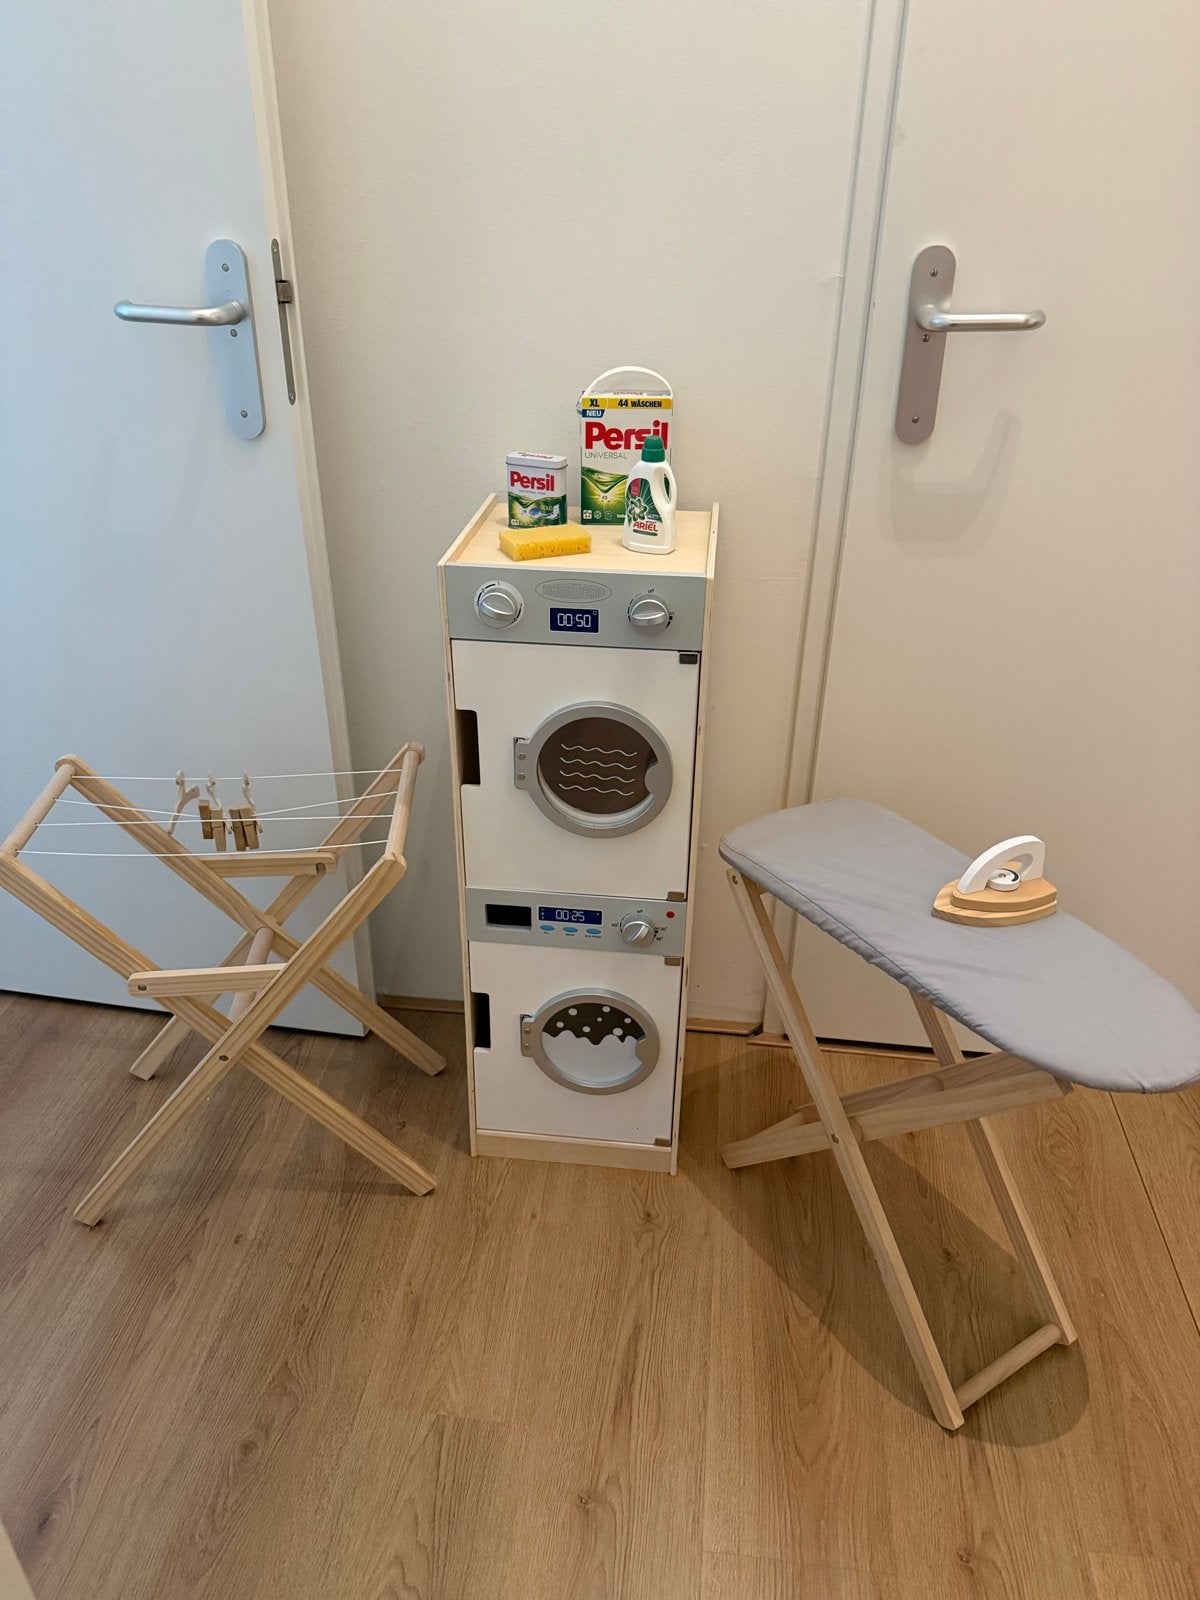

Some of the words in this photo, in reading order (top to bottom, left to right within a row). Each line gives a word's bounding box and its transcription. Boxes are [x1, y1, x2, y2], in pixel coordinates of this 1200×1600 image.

[589, 398, 600, 407] XL
[617, 399, 629, 408] 44
[585, 419, 669, 450] Persil
[584, 451, 628, 459] UNIVERSAL
[510, 470, 555, 492] Persil
[633, 521, 658, 532] ARIEL
[557, 613, 592, 628] 00:50
[555, 909, 585, 921] 00:25
